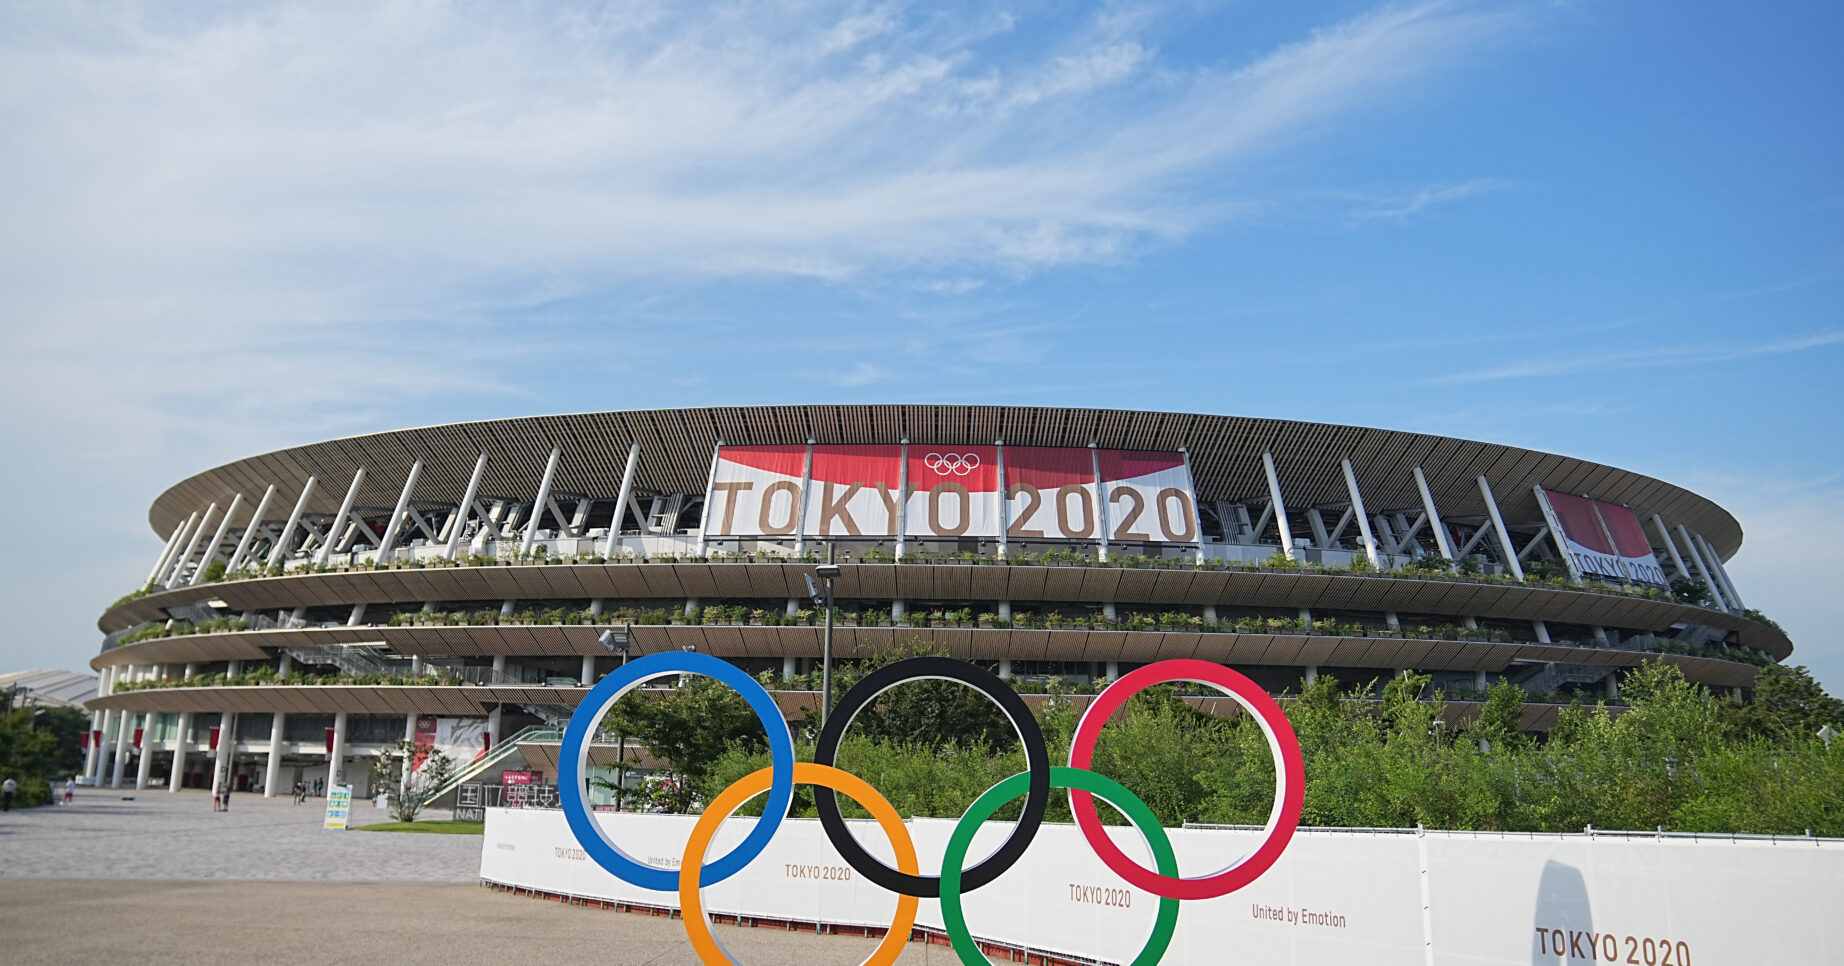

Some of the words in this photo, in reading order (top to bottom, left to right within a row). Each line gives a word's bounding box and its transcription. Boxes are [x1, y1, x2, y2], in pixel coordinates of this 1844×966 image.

[714, 481, 970, 536] TOKYO
[1005, 482, 1196, 542] 2020
[1573, 551, 1631, 578] TOKYO
[1629, 561, 1667, 583] 2020
[457, 783, 561, 808] 国立競技
[456, 808, 485, 820] NATI
[554, 847, 571, 859] TOKYO
[572, 848, 586, 861] 2020
[647, 855, 664, 865] United
[785, 864, 820, 879] TOKYO
[823, 866, 851, 881] 2020
[1069, 884, 1102, 905] TOKYO
[1105, 888, 1131, 908] 2020
[1252, 903, 1284, 921] United
[1287, 907, 1299, 926] by
[1301, 908, 1346, 928] Emotion
[1536, 927, 1618, 963] TOKYO
[1624, 935, 1691, 966] 2020
